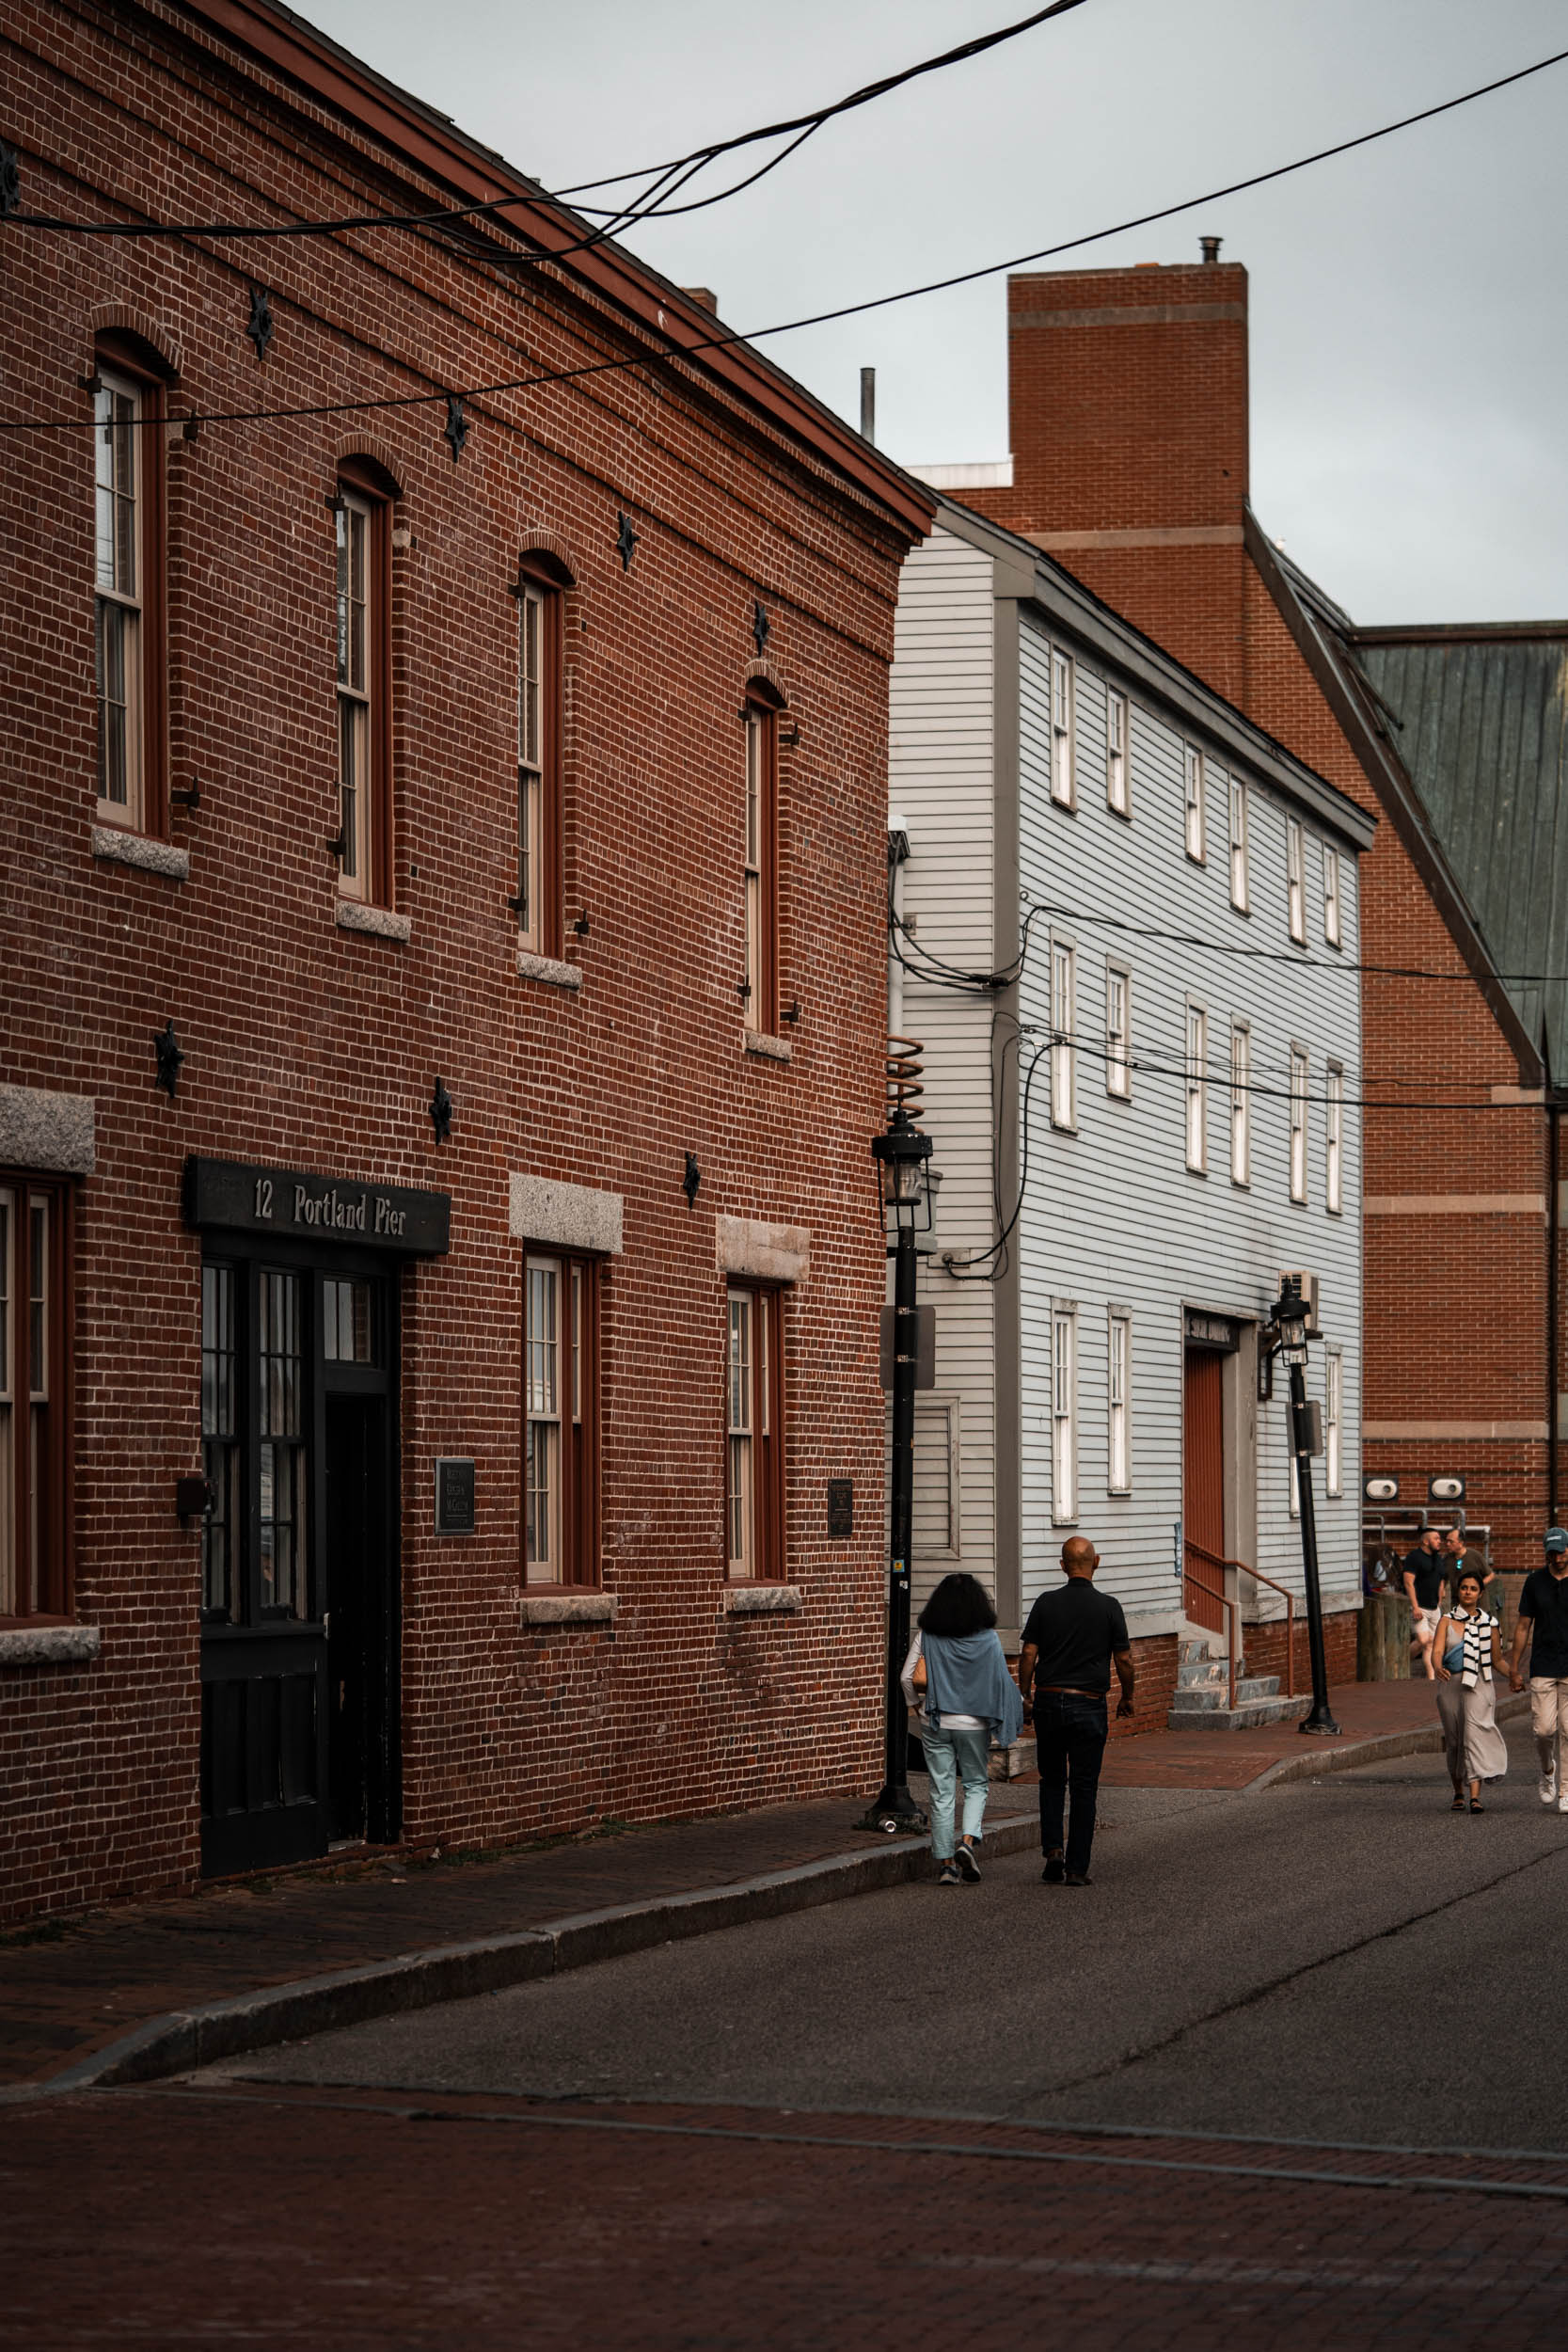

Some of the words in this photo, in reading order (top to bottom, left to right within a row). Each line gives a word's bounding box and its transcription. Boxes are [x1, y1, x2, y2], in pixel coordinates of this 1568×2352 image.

[255, 1179, 273, 1218] 12
[293, 1184, 366, 1231] Portland
[374, 1197, 406, 1235] Pier
